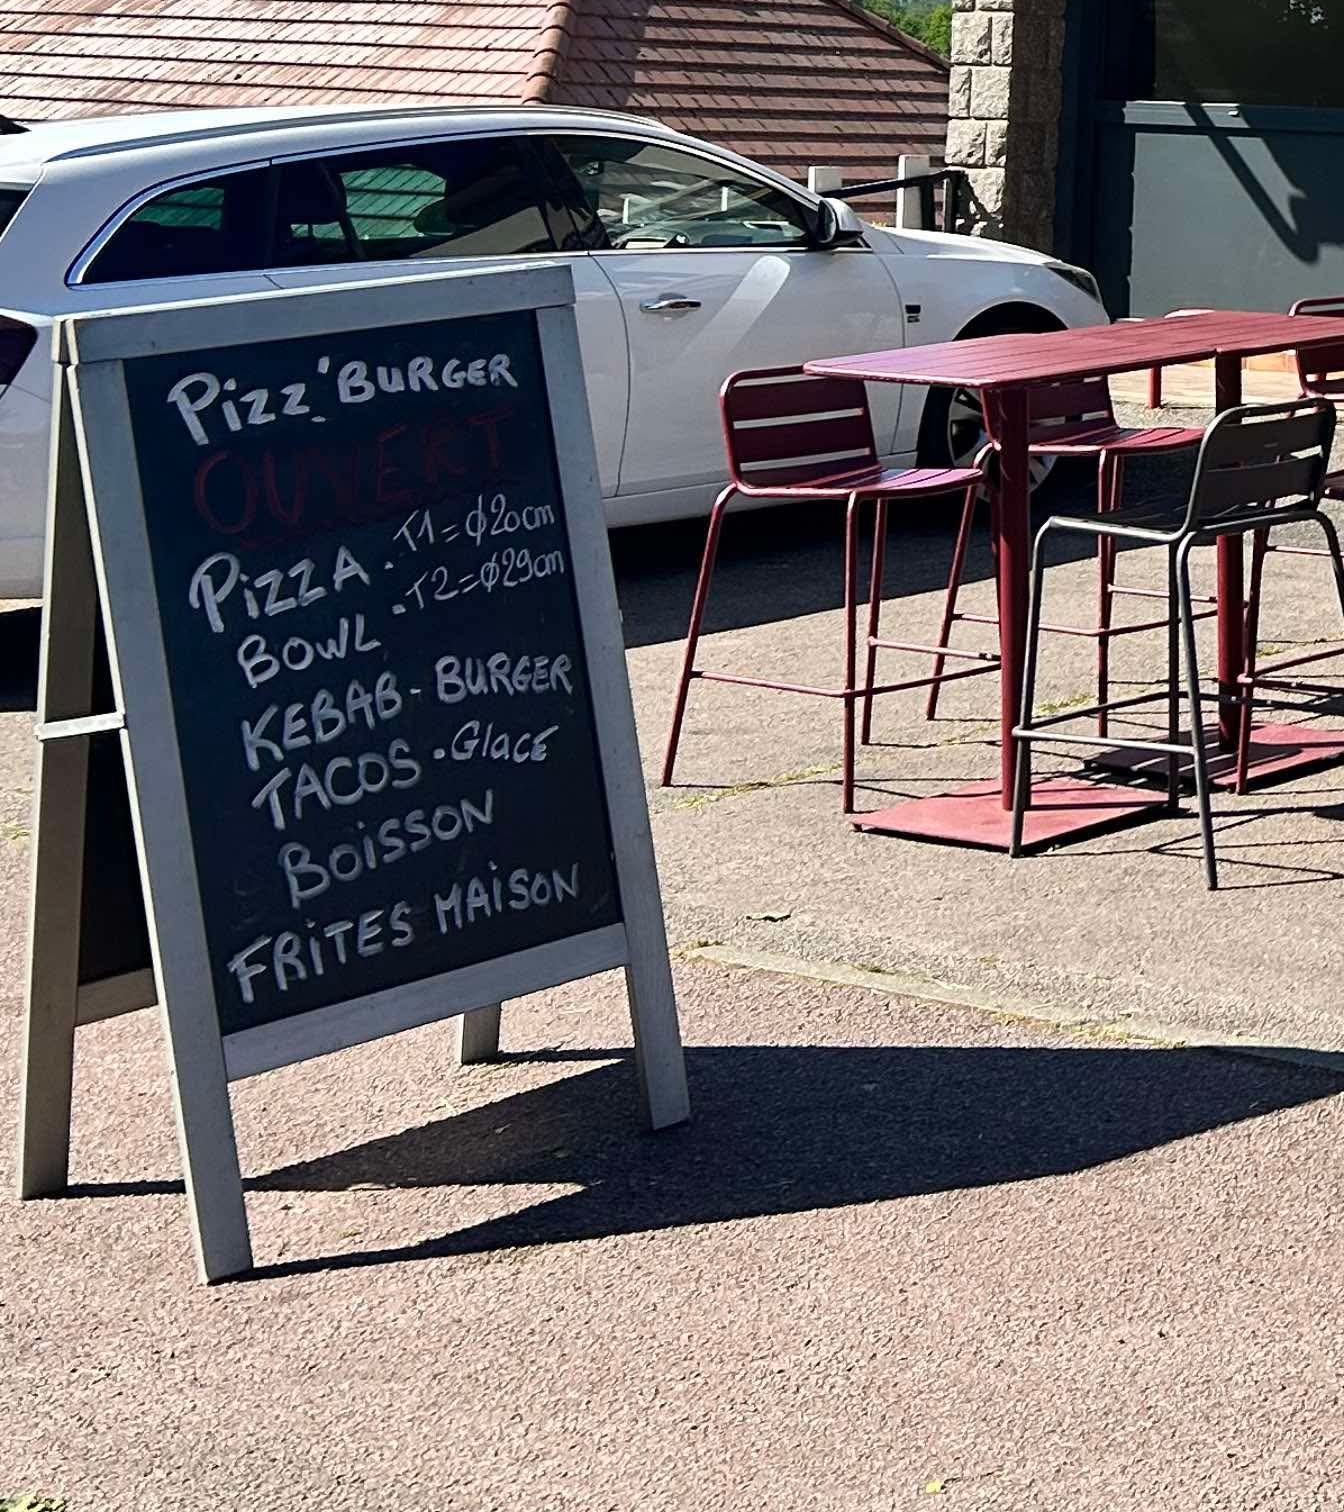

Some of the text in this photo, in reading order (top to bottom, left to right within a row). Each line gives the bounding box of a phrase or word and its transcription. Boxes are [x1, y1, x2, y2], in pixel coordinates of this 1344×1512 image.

[240, 670, 403, 772] KEBAB
[434, 651, 573, 705] BURGER
[251, 738, 423, 831] TACOS
